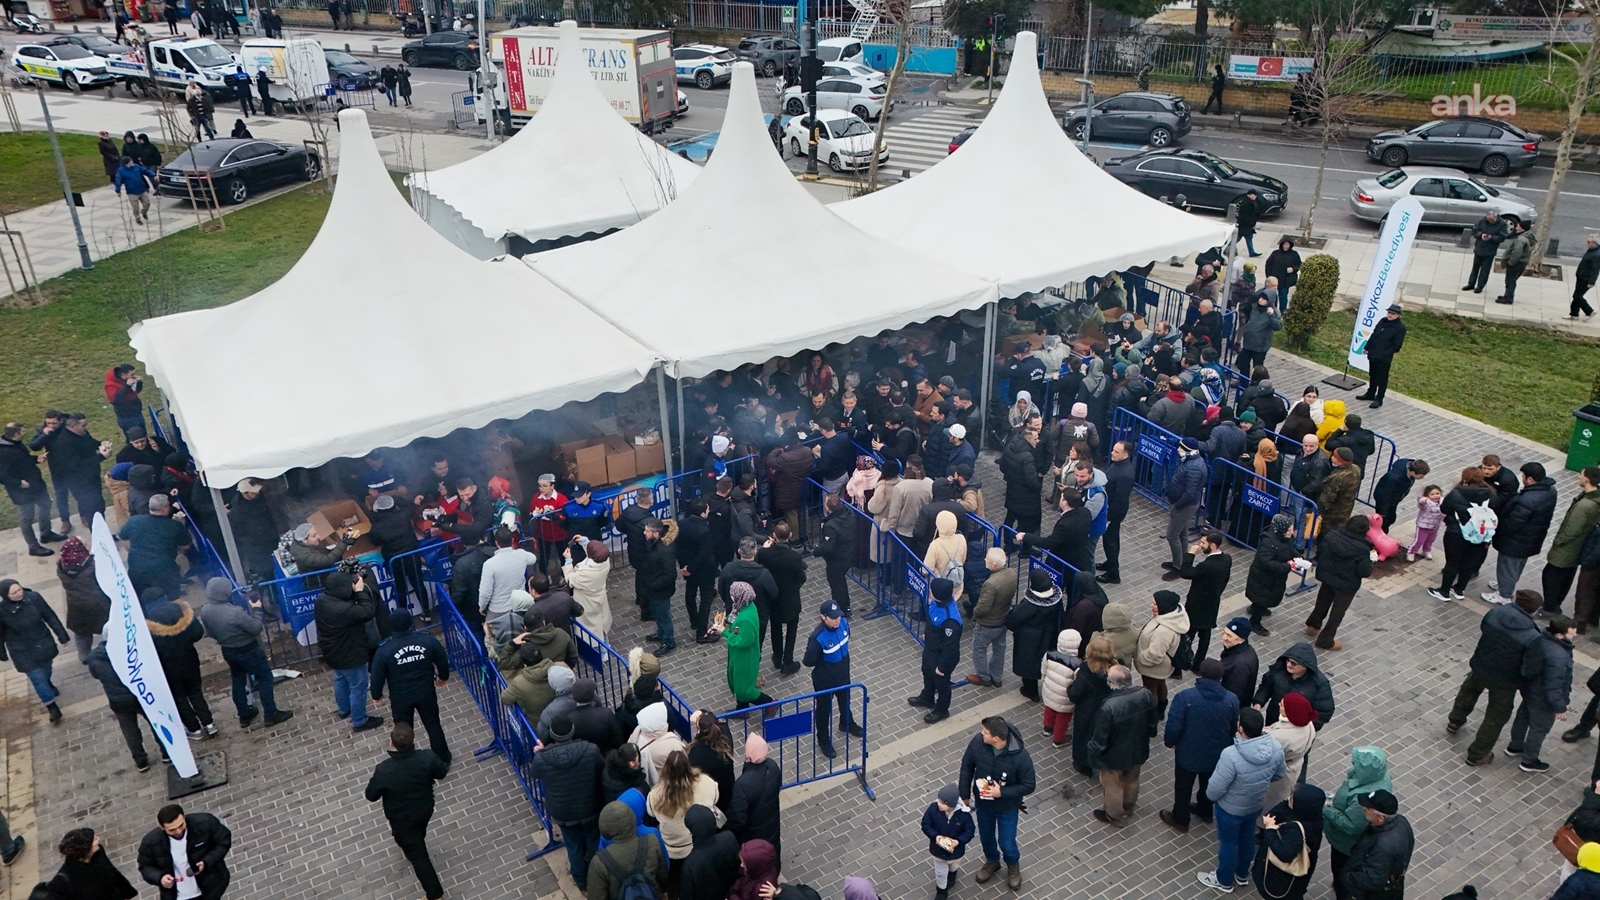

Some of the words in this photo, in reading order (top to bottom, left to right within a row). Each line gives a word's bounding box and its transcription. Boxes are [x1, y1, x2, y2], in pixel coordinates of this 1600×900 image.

[582, 48, 627, 69] RANS
[1141, 439, 1163, 454] BEYKOZ
[1141, 446, 1160, 460] ZABITA
[1247, 489, 1273, 506] BEYKOZ
[1248, 496, 1270, 512] ZABITA
[1033, 561, 1058, 582] BEOZ
[296, 603, 315, 614] ZAB
[393, 645, 426, 660] BEYKOZ
[397, 653, 425, 665] ZABITA
